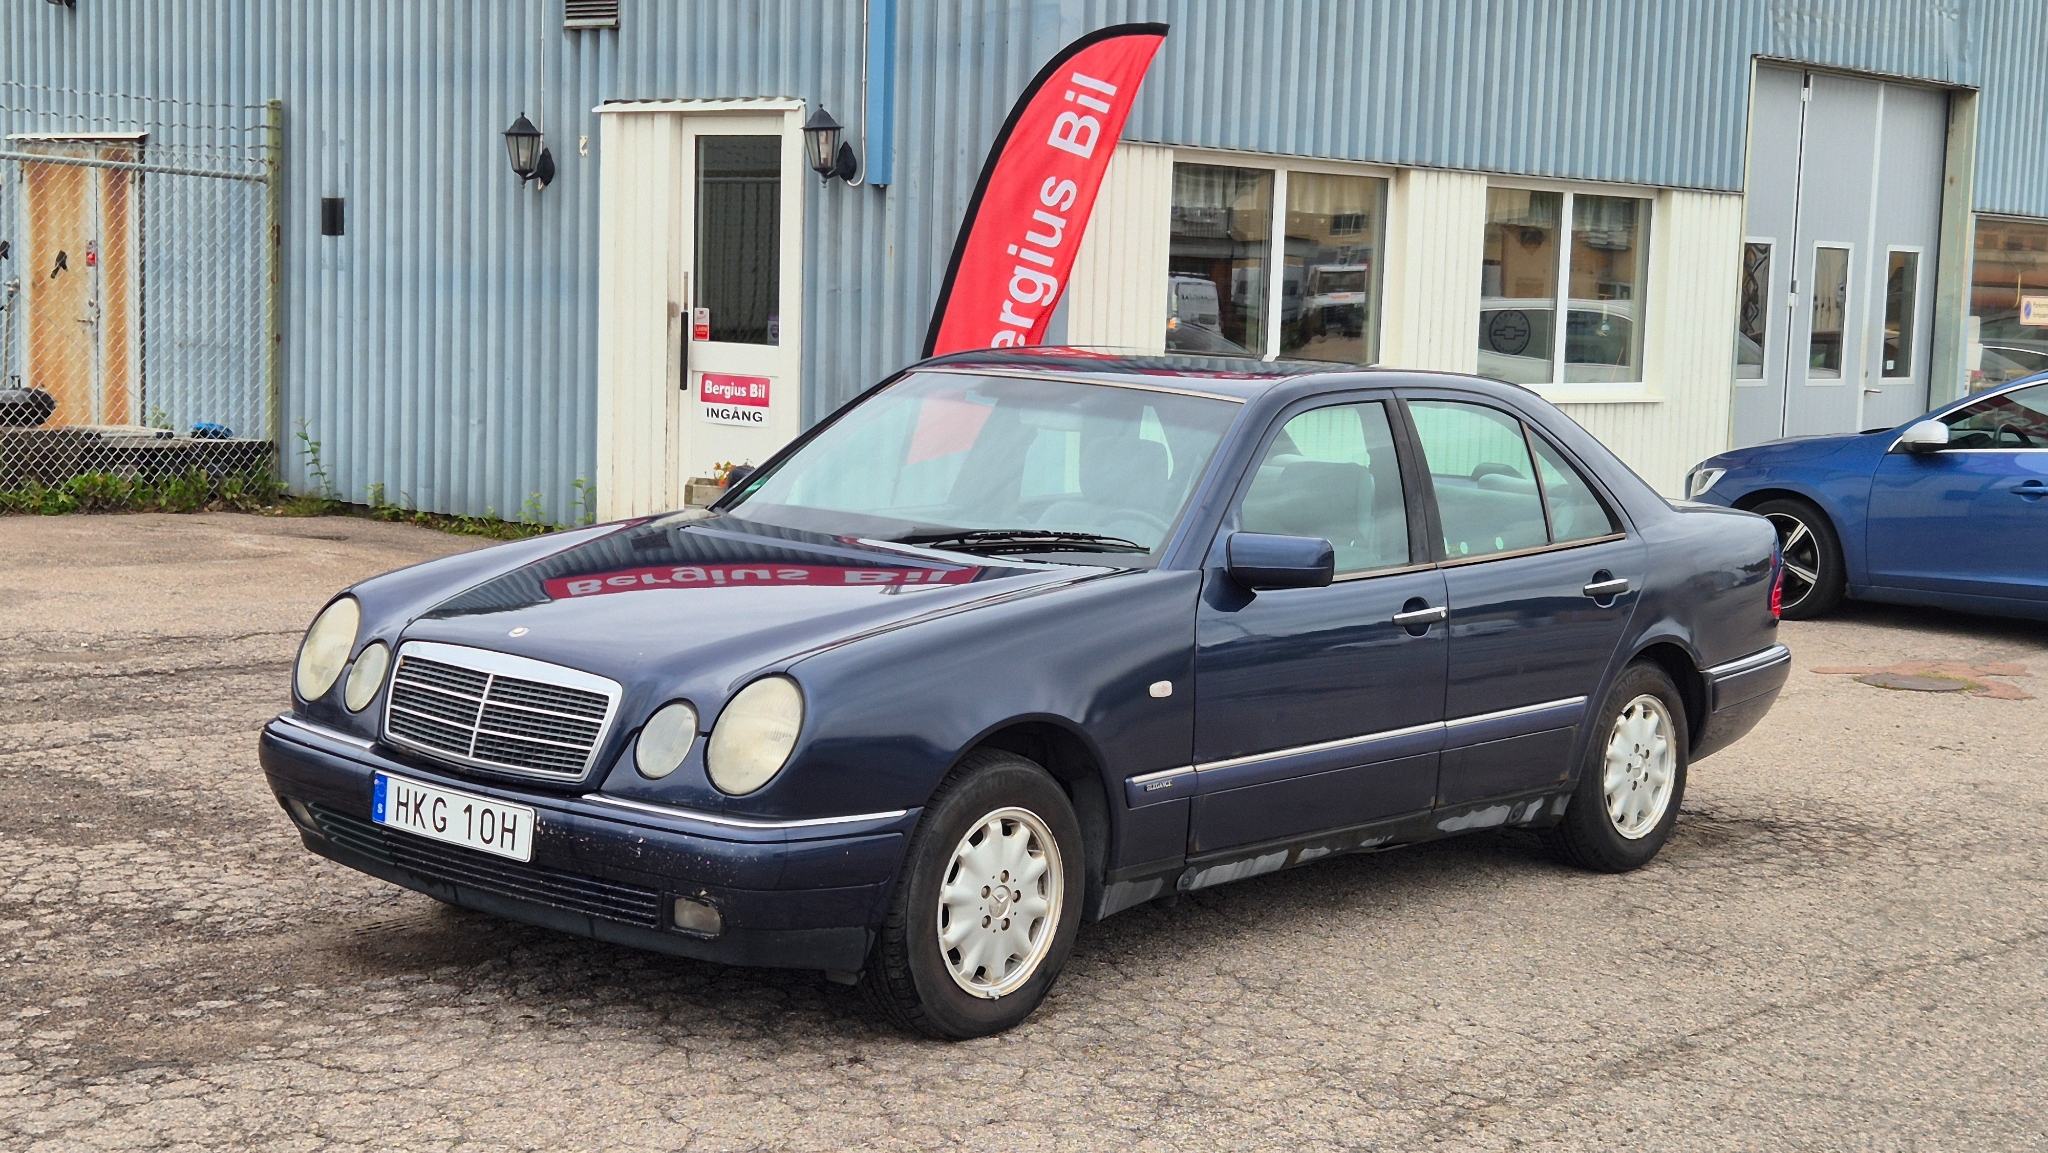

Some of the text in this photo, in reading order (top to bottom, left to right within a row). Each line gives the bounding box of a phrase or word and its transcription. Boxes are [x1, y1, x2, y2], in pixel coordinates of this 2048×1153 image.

[991, 71, 1118, 348] ergius Bil
[704, 380, 766, 399] Bergius Bil
[706, 406, 763, 422] INGÅNG
[376, 802, 384, 814] S
[395, 785, 517, 852] HKG 10H
